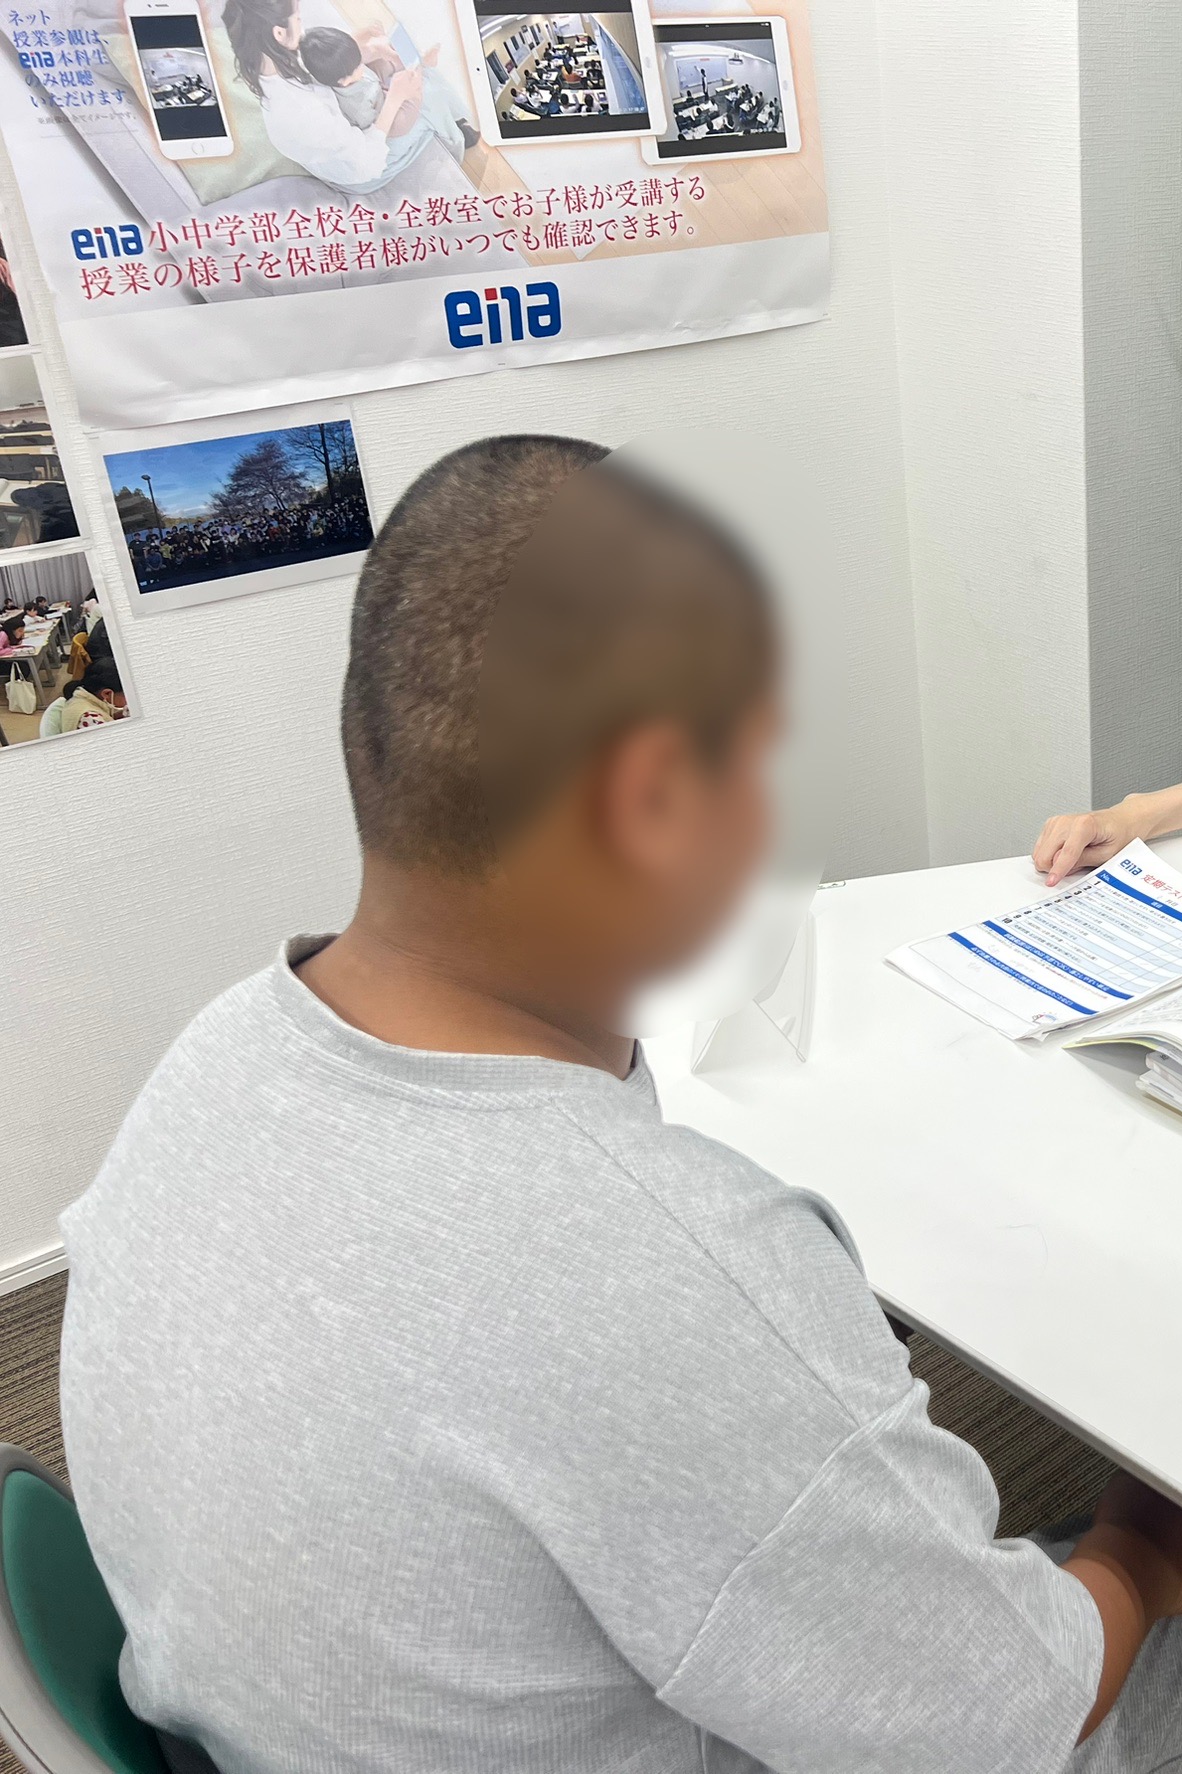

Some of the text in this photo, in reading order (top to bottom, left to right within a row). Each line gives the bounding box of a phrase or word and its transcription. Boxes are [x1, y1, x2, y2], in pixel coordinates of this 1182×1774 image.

[9, 10, 50, 26] ネット
[80, 211, 696, 300] 授業の様子を保護者様がいつでも確認できます。
[444, 281, 562, 349] ena
[1120, 859, 1143, 876] ena
